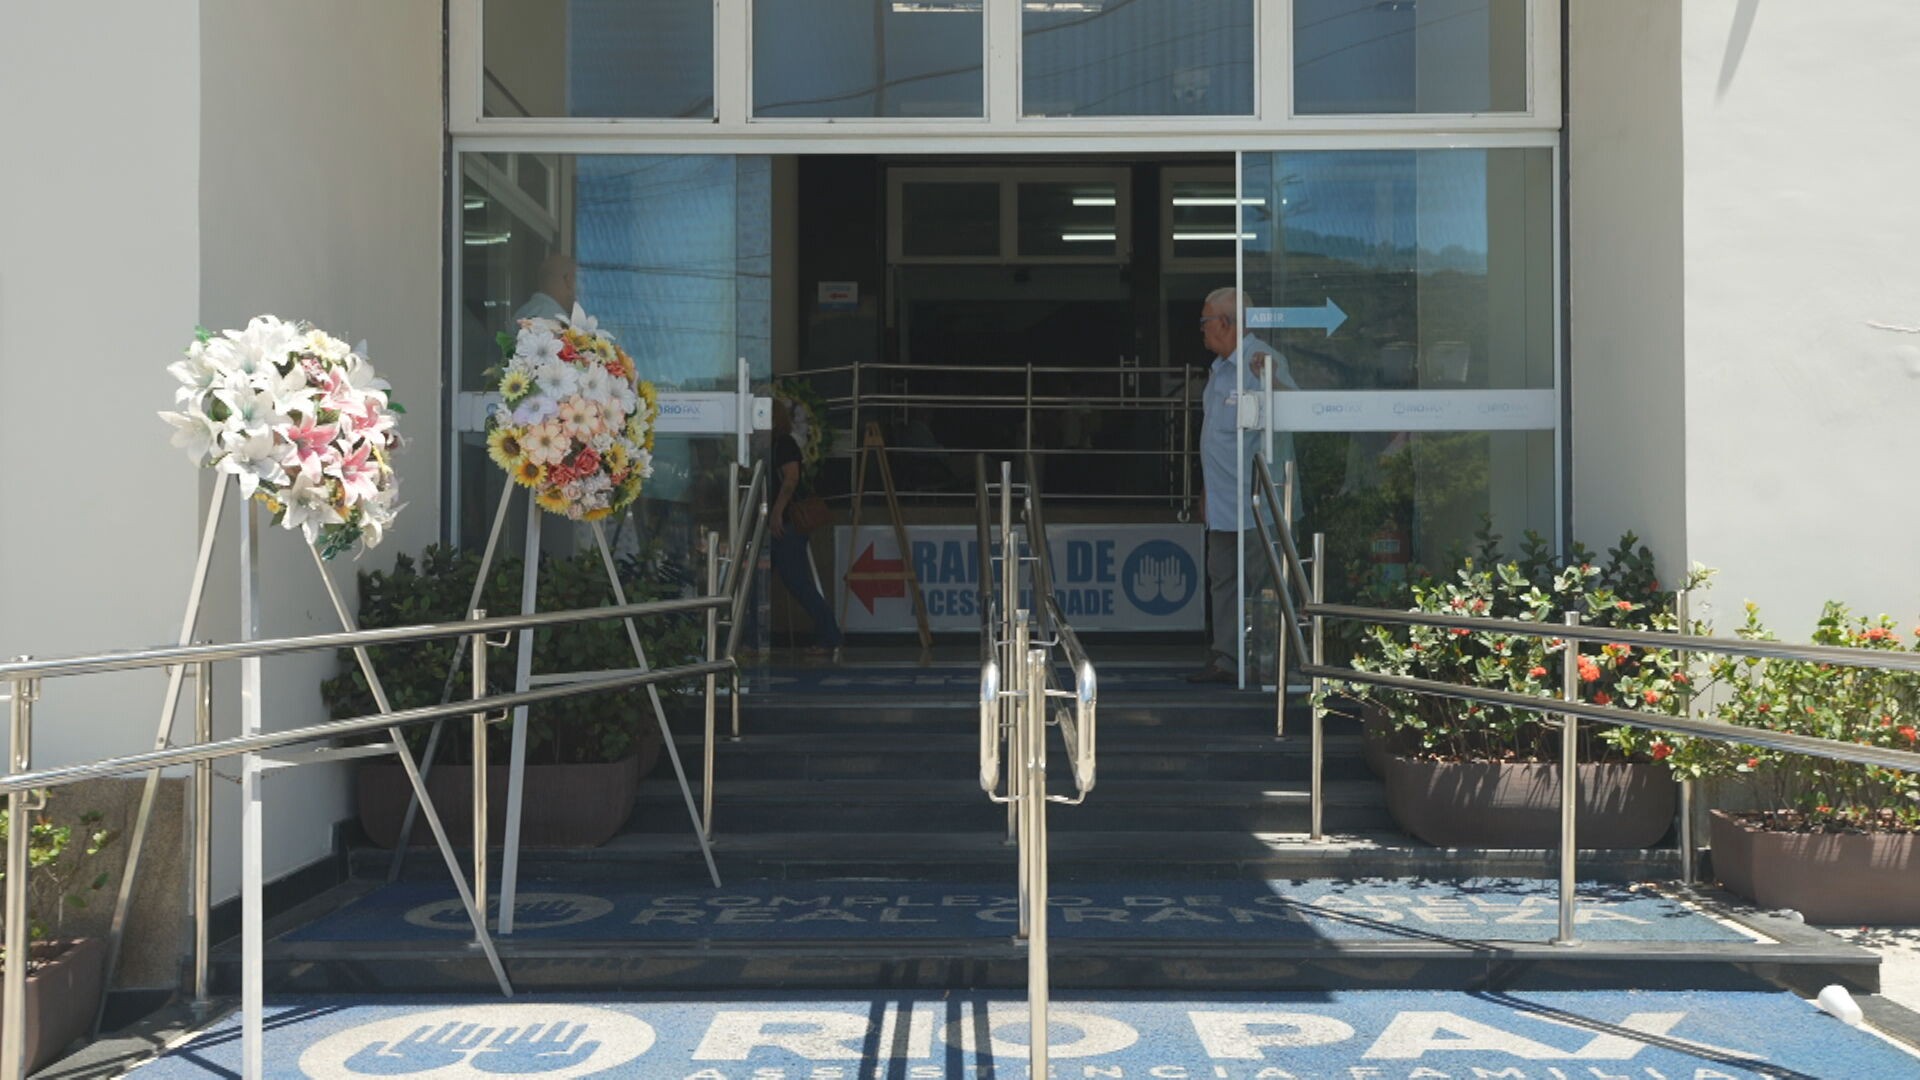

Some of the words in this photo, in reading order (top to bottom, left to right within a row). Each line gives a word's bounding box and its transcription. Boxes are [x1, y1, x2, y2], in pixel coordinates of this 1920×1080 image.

[1250, 312, 1285, 323] ABRIR
[912, 541, 1055, 584] RAMP
[1067, 541, 1115, 583] DE
[1122, 895, 1221, 906] DE
[630, 907, 938, 924] REAL
[690, 1010, 1139, 1061] RIO
[1186, 1010, 1769, 1061] PAX
[1346, 1066, 1773, 1080] FAMILIA
